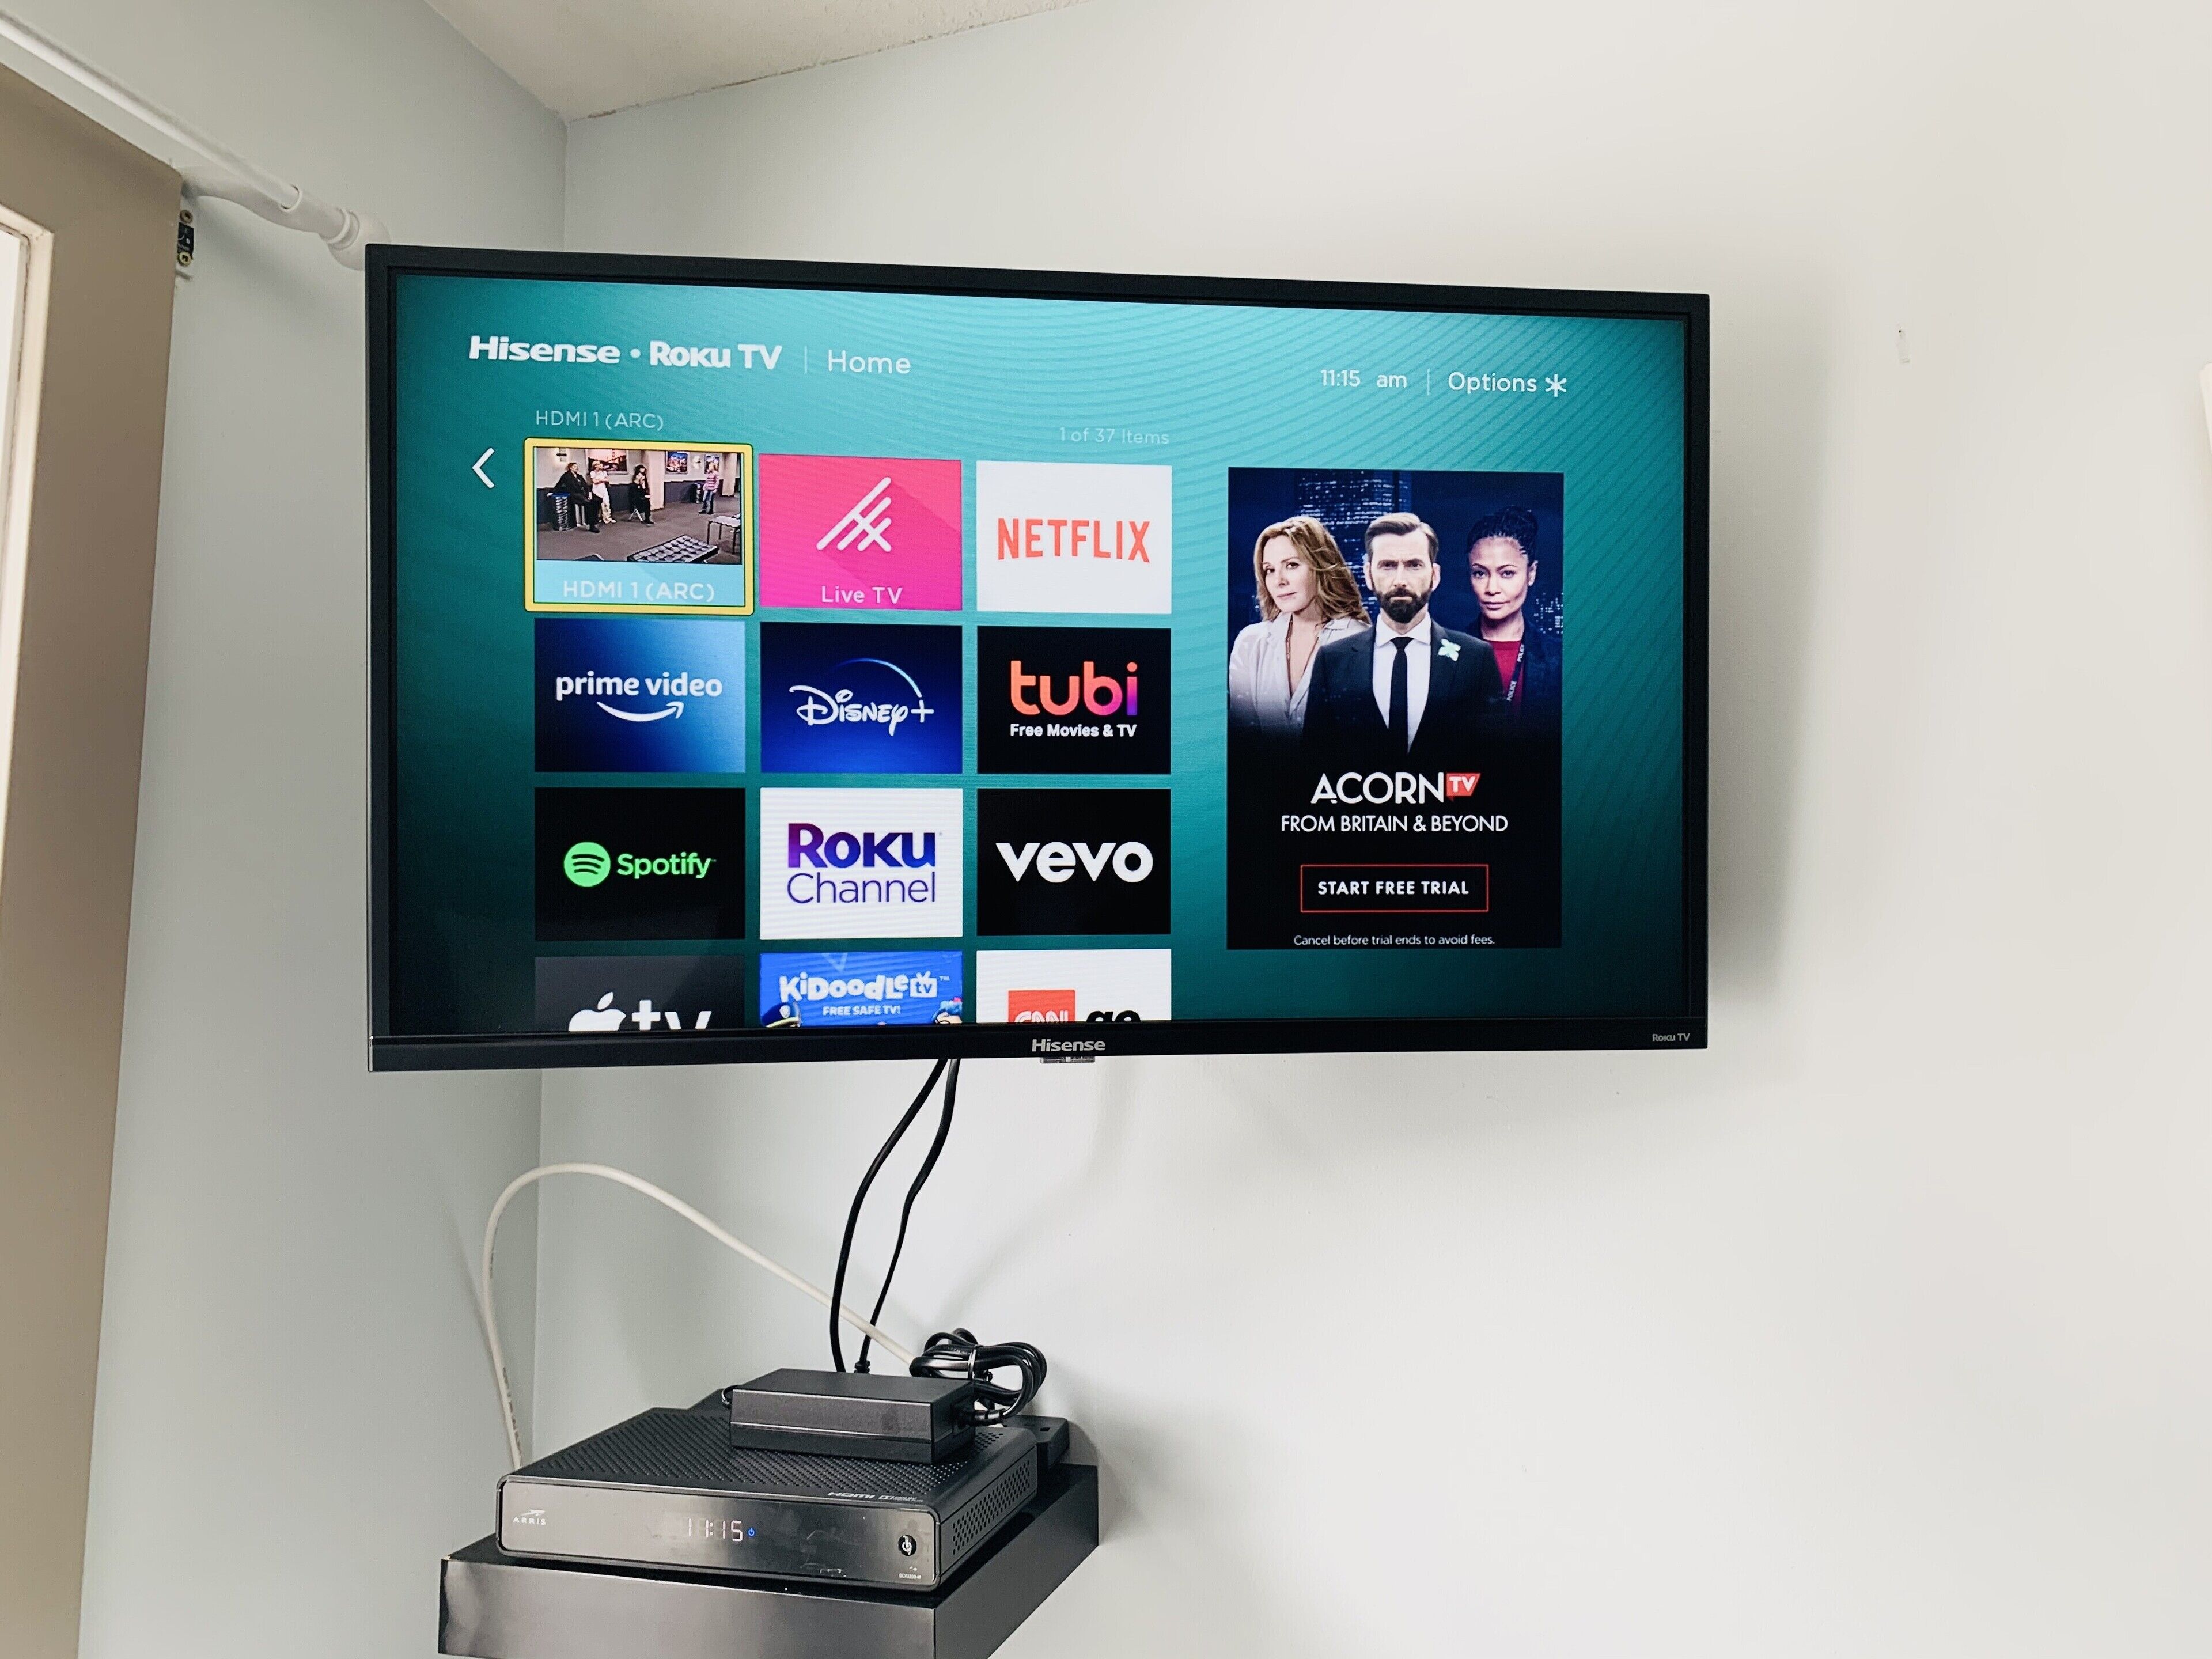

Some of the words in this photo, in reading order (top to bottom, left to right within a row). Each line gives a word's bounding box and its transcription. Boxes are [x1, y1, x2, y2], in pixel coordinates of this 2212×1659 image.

[469, 335, 620, 364] Hisense
[738, 344, 782, 370] TV
[827, 349, 911, 374] Home
[1320, 369, 1361, 387] 11:15
[1376, 372, 1408, 388] am
[1448, 372, 1537, 393] Options
[536, 410, 587, 427] HDMI
[593, 412, 599, 427] 1
[605, 412, 664, 431] (ARC)
[1060, 427, 1066, 441] 1
[1071, 427, 1089, 442] of
[1095, 428, 1115, 442] 37
[1122, 429, 1169, 444] Items
[998, 518, 1151, 563] NETFLIX
[563, 580, 622, 599] HDMI
[630, 582, 638, 599] 1
[646, 582, 715, 603] (ARC)
[821, 585, 865, 604] Live
[872, 586, 903, 605] TV
[556, 670, 639, 701] prime
[645, 671, 723, 698] video
[1010, 661, 1138, 715] tubi
[1010, 723, 1043, 737] Free
[1047, 723, 1099, 737] Movies
[1103, 724, 1114, 737] &
[1116, 724, 1138, 737] TV
[1310, 772, 1444, 804] ACORN
[1449, 775, 1476, 794] TV
[1281, 815, 1335, 832] FROM
[1340, 815, 1408, 832] BRITAIN
[1412, 816, 1427, 832] &
[1431, 815, 1508, 832] BEYOND
[617, 851, 713, 879] Spotify
[995, 842, 1153, 883] vevo
[787, 871, 935, 903] Channel
[1317, 881, 1369, 895] START
[1375, 881, 1415, 895] FREE
[1421, 881, 1469, 895] TRIAL
[1293, 935, 1331, 945] Cancel
[1334, 935, 1369, 945] before
[1372, 935, 1392, 945] trial
[1395, 935, 1421, 945] ends
[1425, 935, 1436, 945] to
[1438, 934, 1468, 945] avoid
[1471, 934, 1495, 945] fees.
[823, 1006, 851, 1016] FREE
[853, 1005, 881, 1016] SAFE
[883, 1005, 901, 1015] TV!
[1032, 1039, 1106, 1052] Hisense
[1677, 1033, 1691, 1041] TV
[513, 1516, 547, 1525] ARRIS
[688, 1518, 743, 1542] 11:15
